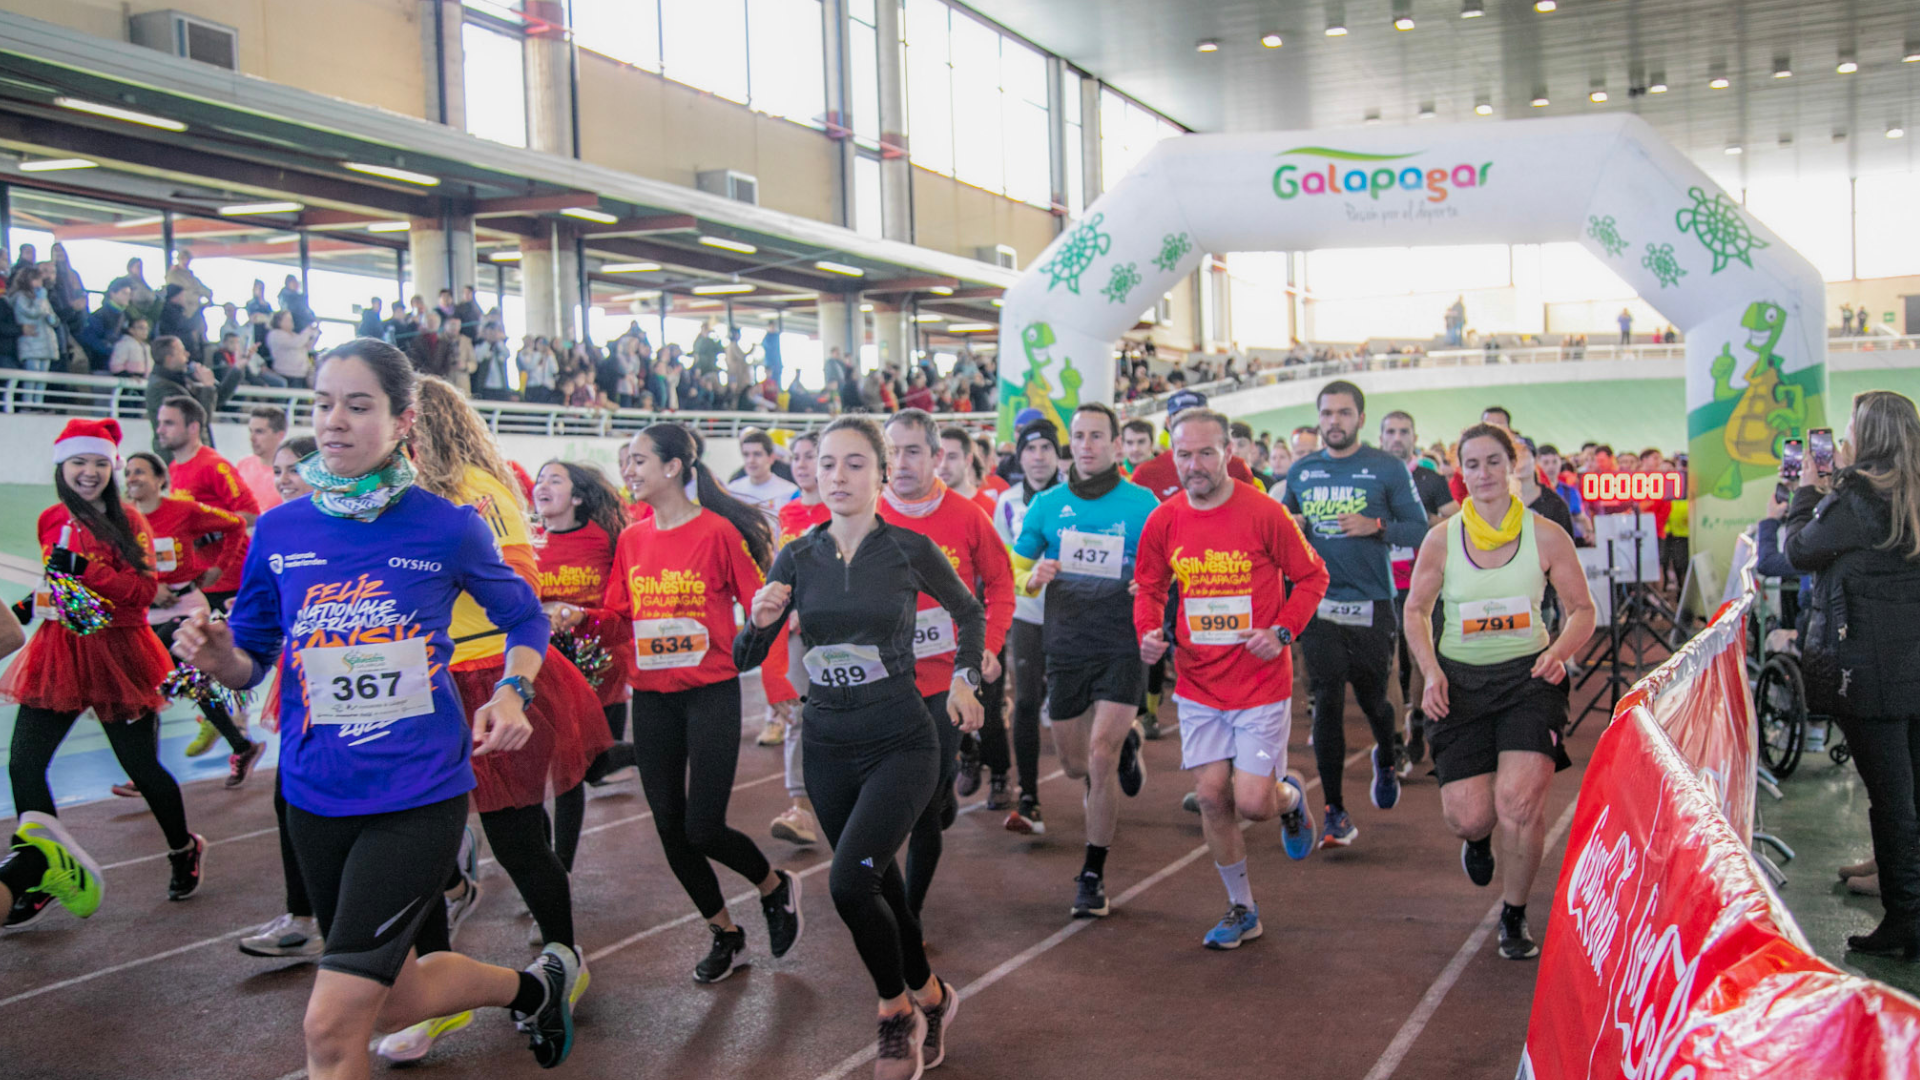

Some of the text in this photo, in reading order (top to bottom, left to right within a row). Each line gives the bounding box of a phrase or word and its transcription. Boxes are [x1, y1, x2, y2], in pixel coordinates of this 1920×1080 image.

[1272, 161, 1493, 203] Galapagar
[1313, 486, 1330, 501] NO
[1330, 486, 1354, 501] HAY
[1302, 497, 1368, 517] EXCUSAS
[1073, 549, 1109, 564] 437
[1204, 549, 1229, 561] San
[388, 557, 442, 572] OYSHO
[559, 565, 583, 575] San
[1180, 557, 1253, 573] Silvestre
[661, 568, 681, 580] San
[1191, 573, 1252, 585] GALAPAGAR
[302, 573, 392, 610] FELIZ
[634, 576, 705, 594] Silvestre
[643, 595, 706, 607] GALAPAGAR
[297, 598, 397, 621] NATIONALE
[1330, 604, 1362, 616] 292
[1200, 615, 1239, 631] 990
[1476, 616, 1515, 631] 791
[651, 636, 693, 654] 634
[821, 665, 866, 687] 489
[332, 671, 402, 701] 367
